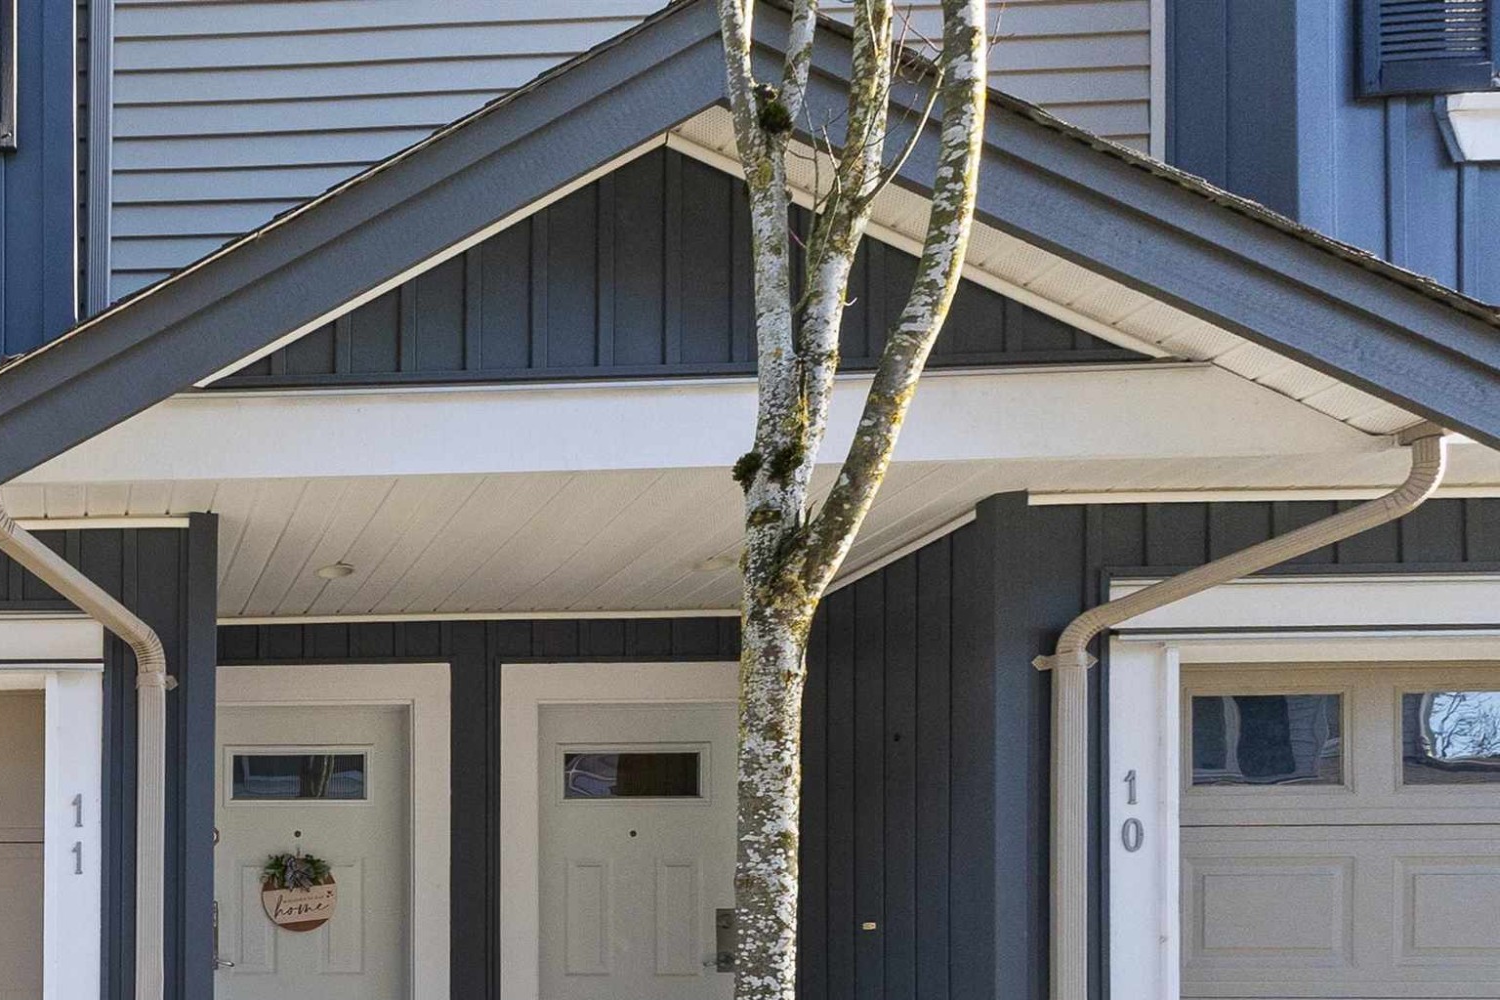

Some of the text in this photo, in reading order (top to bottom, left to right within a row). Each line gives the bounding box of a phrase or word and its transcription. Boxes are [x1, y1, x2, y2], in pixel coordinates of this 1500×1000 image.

[71, 793, 83, 875] 11
[1121, 769, 1144, 853] 10
[274, 894, 329, 919] home
